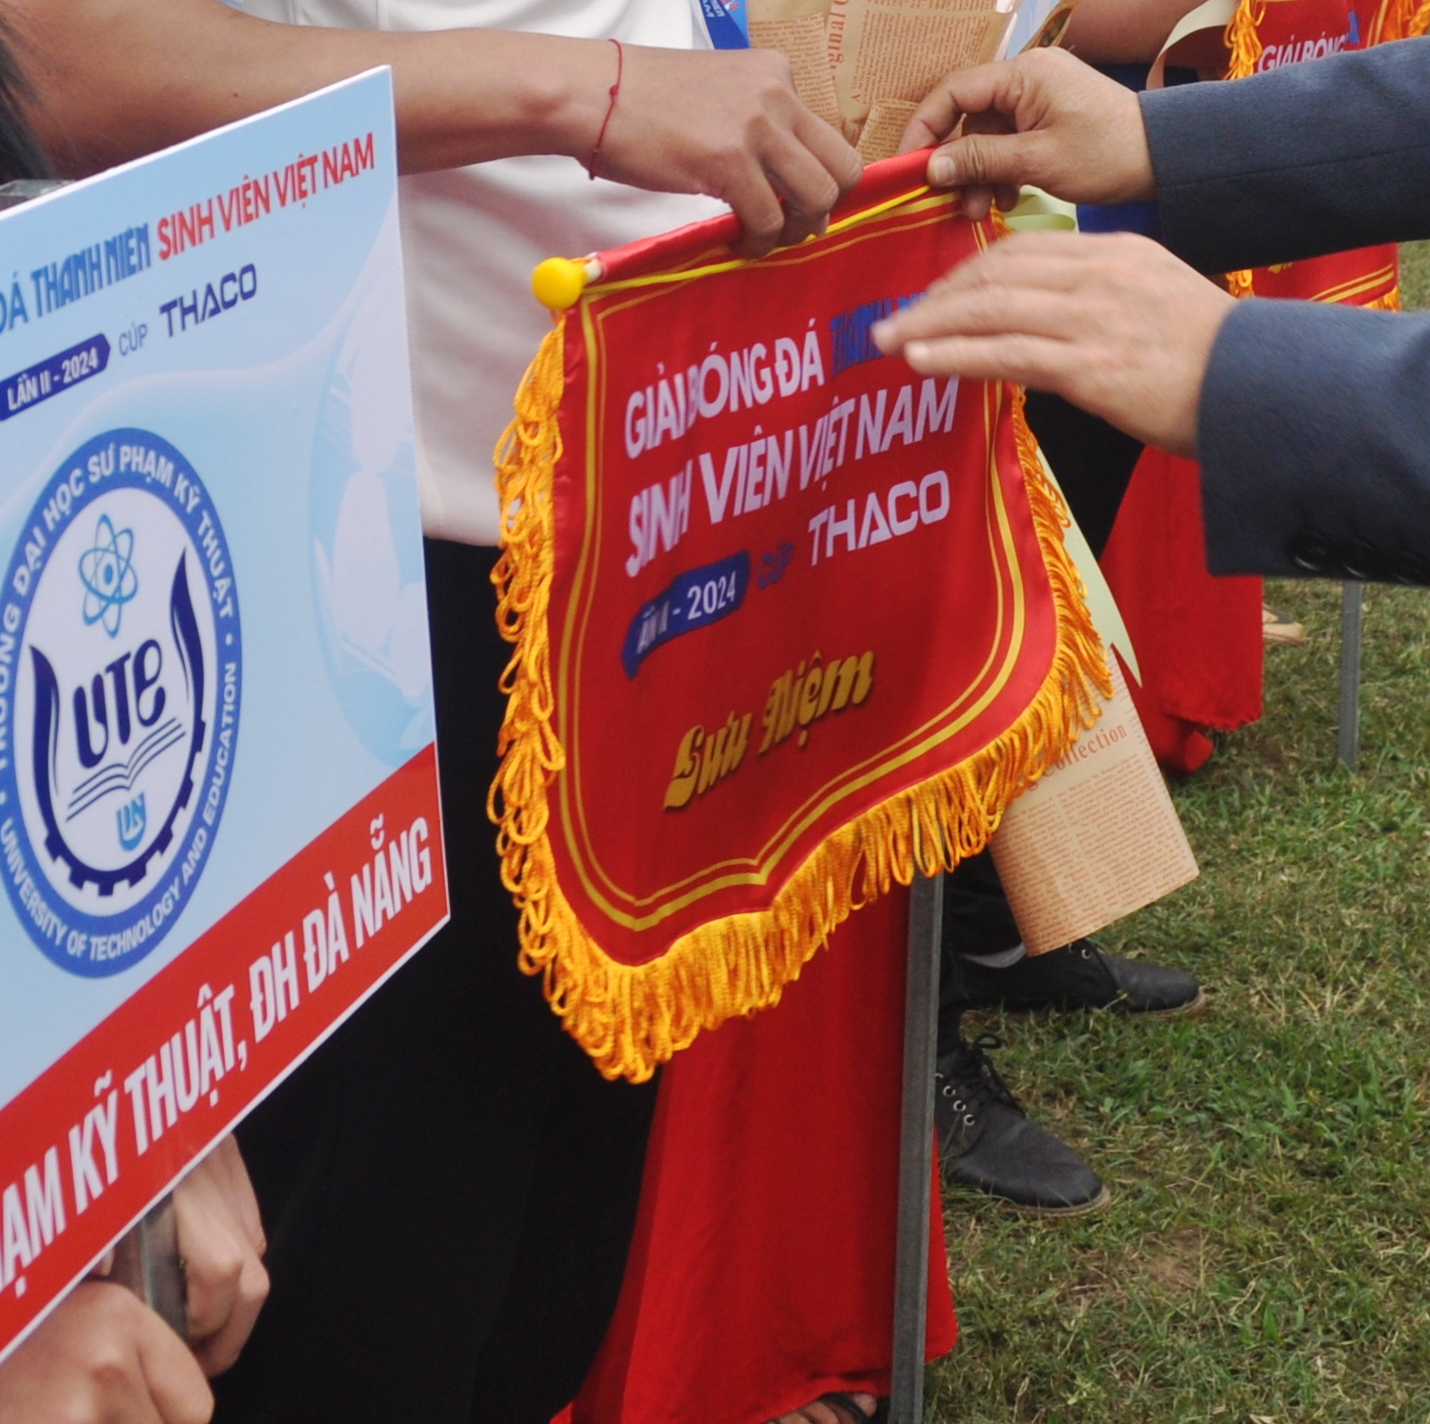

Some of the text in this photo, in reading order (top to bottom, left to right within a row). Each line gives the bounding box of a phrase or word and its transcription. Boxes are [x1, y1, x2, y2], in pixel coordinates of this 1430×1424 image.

[30, 242, 104, 319] THANH
[103, 222, 152, 287] NIÊN
[157, 198, 215, 261] SINH
[217, 174, 271, 233] VIÊN
[273, 153, 319, 209] VIỆT
[322, 132, 375, 190] NAM
[7, 369, 39, 412] LẦN
[39, 369, 52, 396] II
[61, 347, 99, 385] 2024
[118, 322, 148, 357] CÚP
[159, 263, 258, 339] THACO
[625, 362, 687, 459] GIẢI
[686, 341, 774, 430] BÓNG
[775, 317, 825, 398] ĐÁ
[12, 527, 48, 596] ĐẠI
[42, 466, 86, 520] HỌC
[88, 442, 117, 480] SƯ
[119, 443, 175, 486] PHẠM
[173, 470, 202, 516] KỸ
[197, 507, 234, 621] THUẬT
[625, 373, 961, 578] SINH VIÊN VIỆT NAM
[686, 570, 737, 621] 2024
[807, 470, 951, 567] THACO
[66, 933, 88, 959] OF
[88, 882, 183, 962] TECHNOLOGY
[180, 833, 209, 889] AND
[202, 661, 237, 838] EDUCATION
[67, 1069, 120, 1216] KỸ
[123, 982, 249, 1156] THUẬT,
[247, 943, 299, 1044] ĐH
[301, 870, 352, 996] ĐÀ
[349, 811, 434, 950] NẴNG
